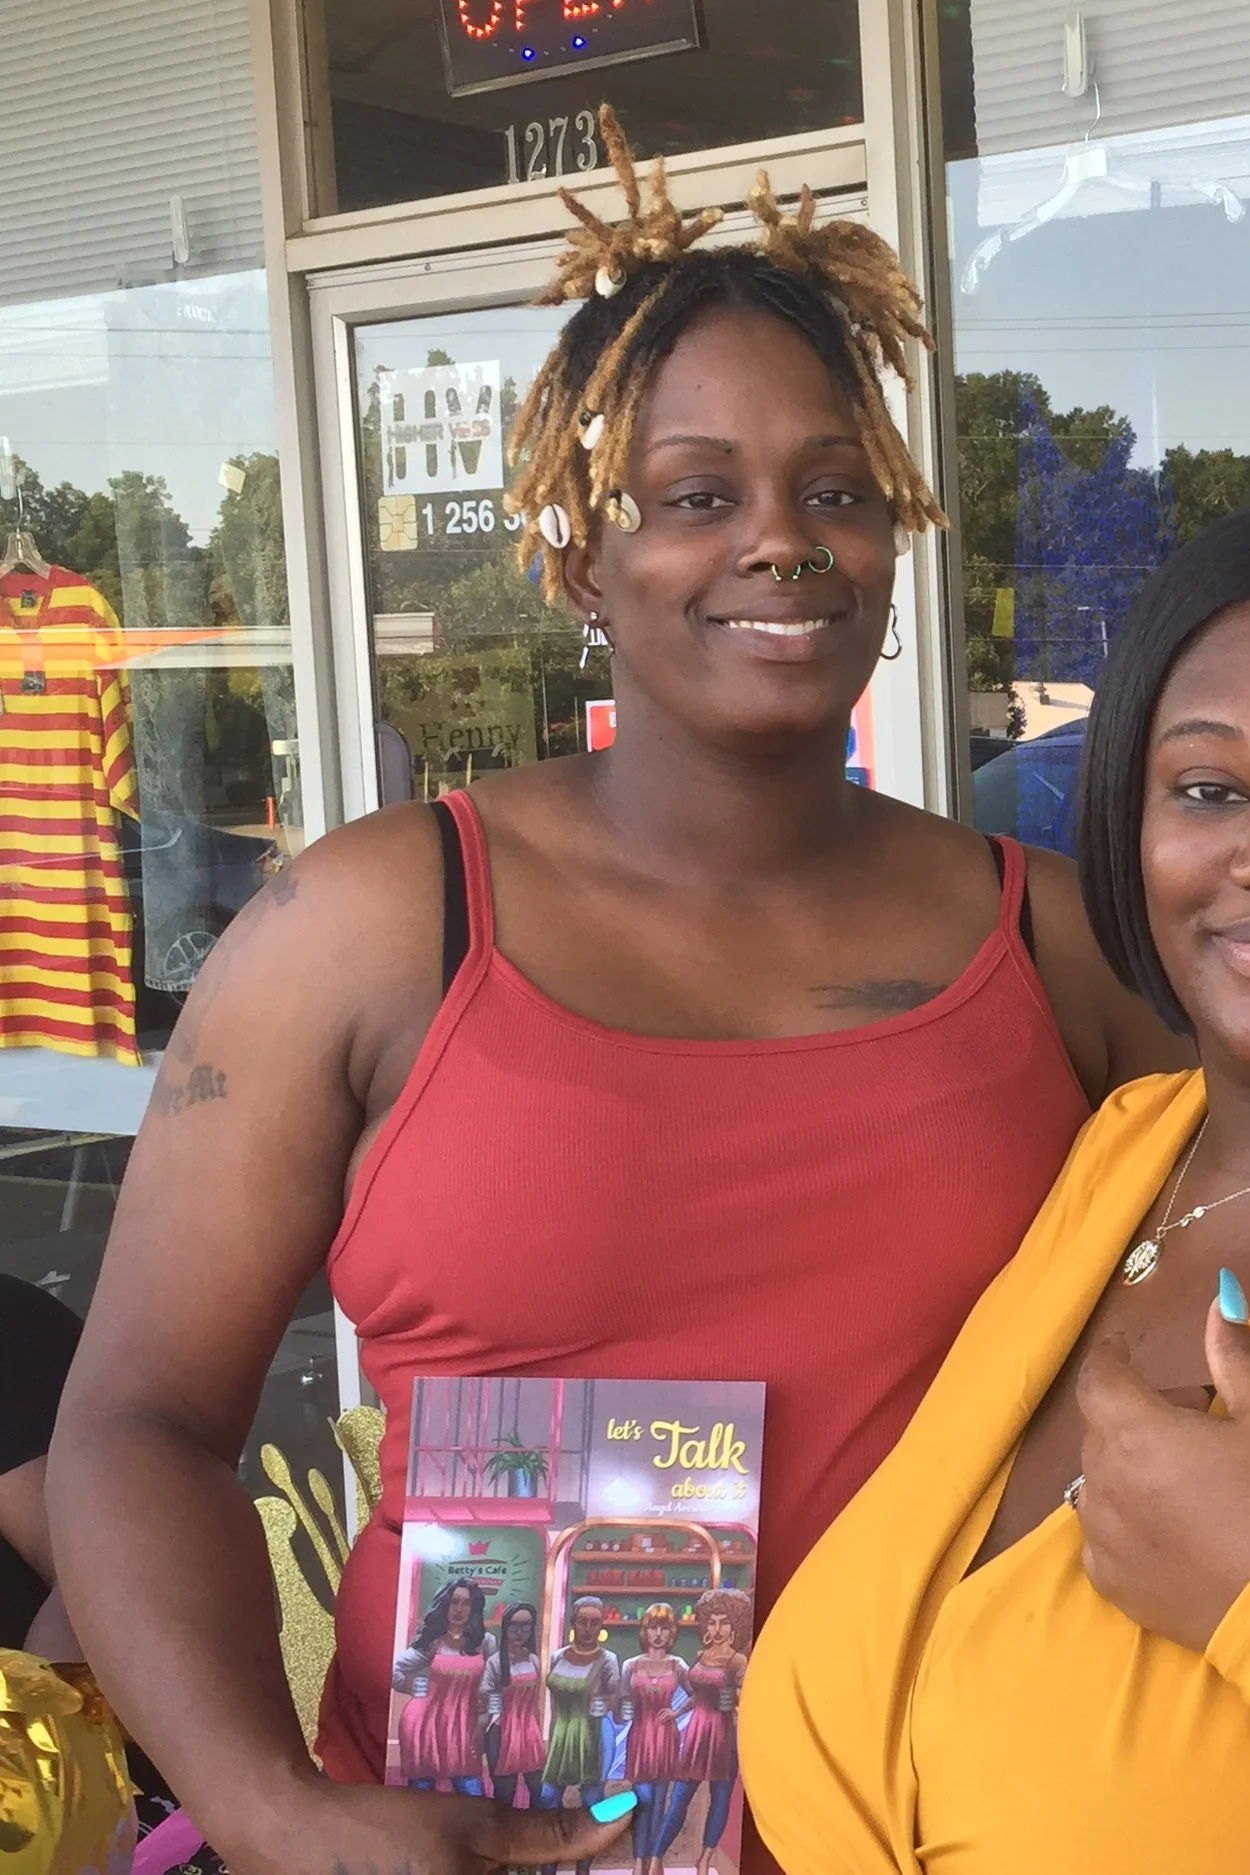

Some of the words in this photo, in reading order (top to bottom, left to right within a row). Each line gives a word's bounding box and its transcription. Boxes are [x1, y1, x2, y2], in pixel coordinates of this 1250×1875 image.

[505, 110, 598, 184] 1273
[422, 503, 434, 535] 1
[445, 499, 496, 534] 256
[606, 1418, 645, 1440] let's
[650, 1420, 749, 1474] Talk
